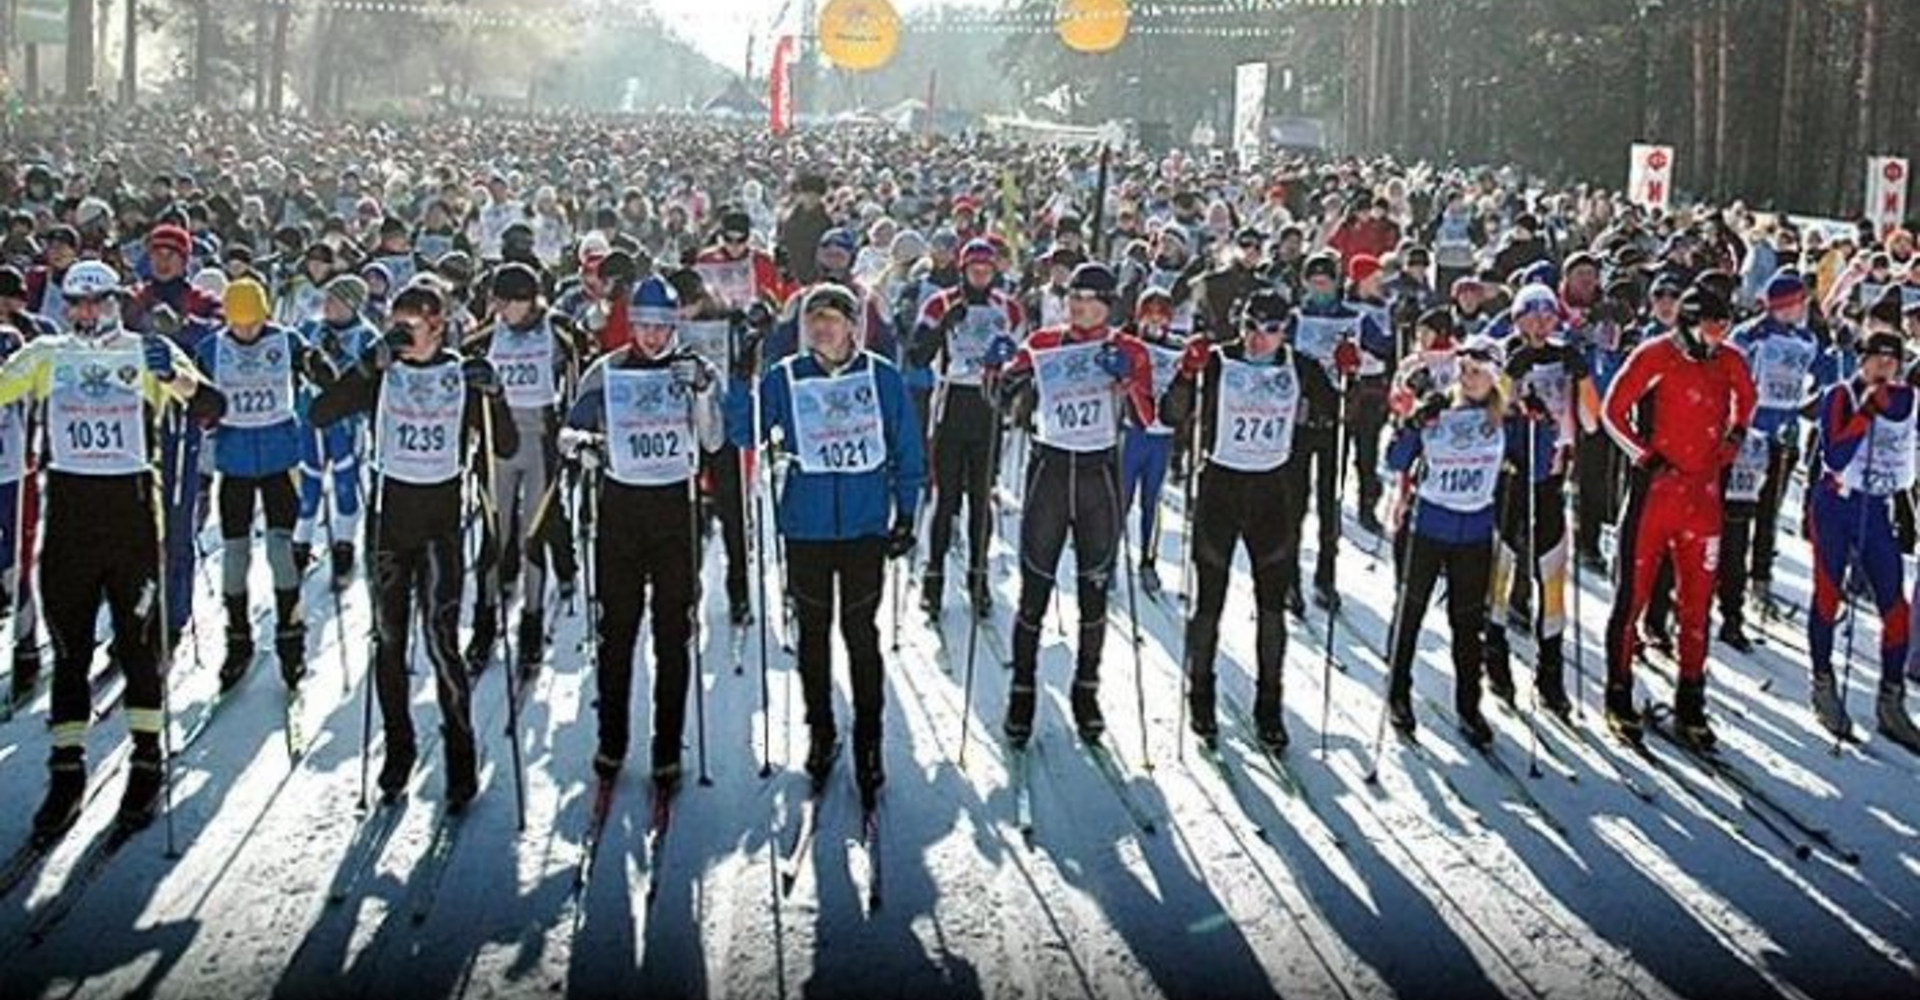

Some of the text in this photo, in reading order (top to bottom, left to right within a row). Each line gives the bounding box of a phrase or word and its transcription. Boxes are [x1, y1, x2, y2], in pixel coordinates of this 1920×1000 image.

[233, 388, 276, 413] 1223
[1055, 399, 1102, 429] 1027
[66, 420, 124, 449] 1031
[396, 422, 446, 453] 1239
[628, 430, 679, 459] 1002
[816, 439, 868, 467] 1021
[1440, 467, 1485, 492] 1100
